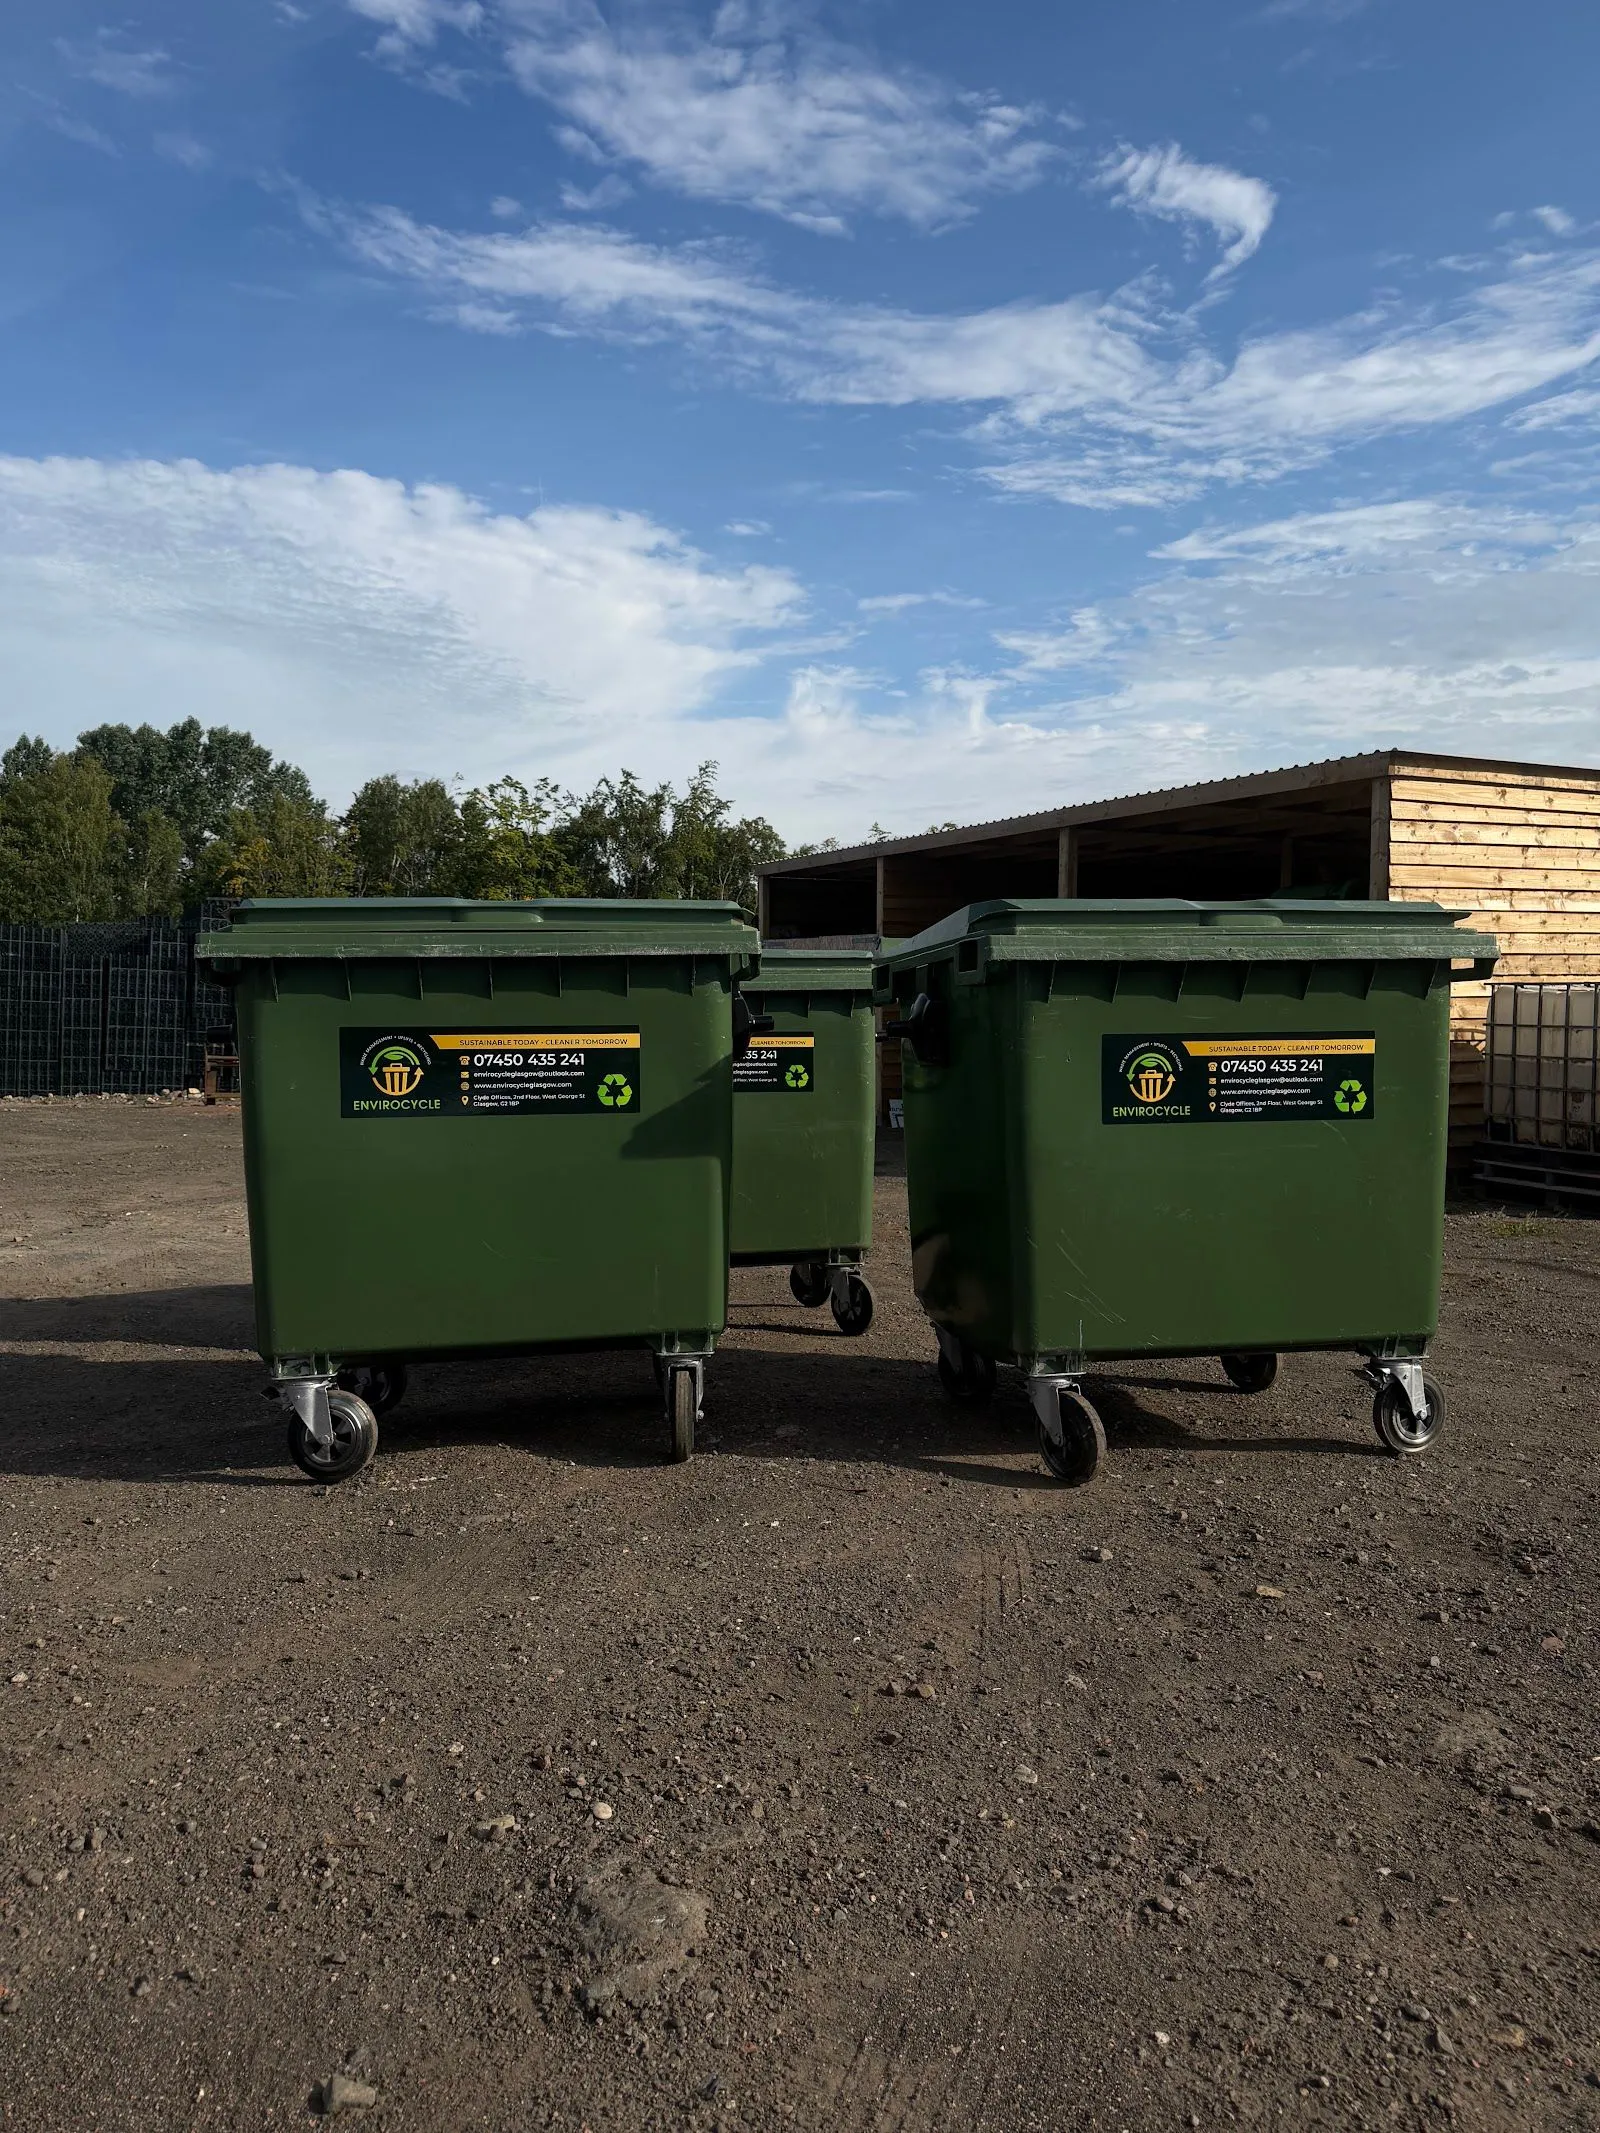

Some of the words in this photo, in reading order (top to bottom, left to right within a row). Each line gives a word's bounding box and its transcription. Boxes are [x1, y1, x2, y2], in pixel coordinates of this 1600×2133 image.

[1208, 1045, 1257, 1053] SUSTAINABLE
[742, 1050, 758, 1059] 35
[760, 1050, 777, 1059] 241
[473, 1053, 524, 1067] 07450
[527, 1053, 557, 1066] 435
[559, 1053, 585, 1066] 241
[1221, 1060, 1267, 1073] 07450
[1270, 1059, 1297, 1072] 435
[1300, 1059, 1323, 1072] 241
[473, 1070, 585, 1079] envirocycleglasgow@outlook.com
[1220, 1076, 1323, 1085] envirocycleglasgow@outlook.com
[473, 1082, 572, 1090] www.envirocycleglasgow.com
[1220, 1088, 1311, 1096] www.envirocycleglasgow.com
[353, 1099, 441, 1111] ENVIROCYCLE
[1112, 1106, 1191, 1117] ENVIROCYCLE
